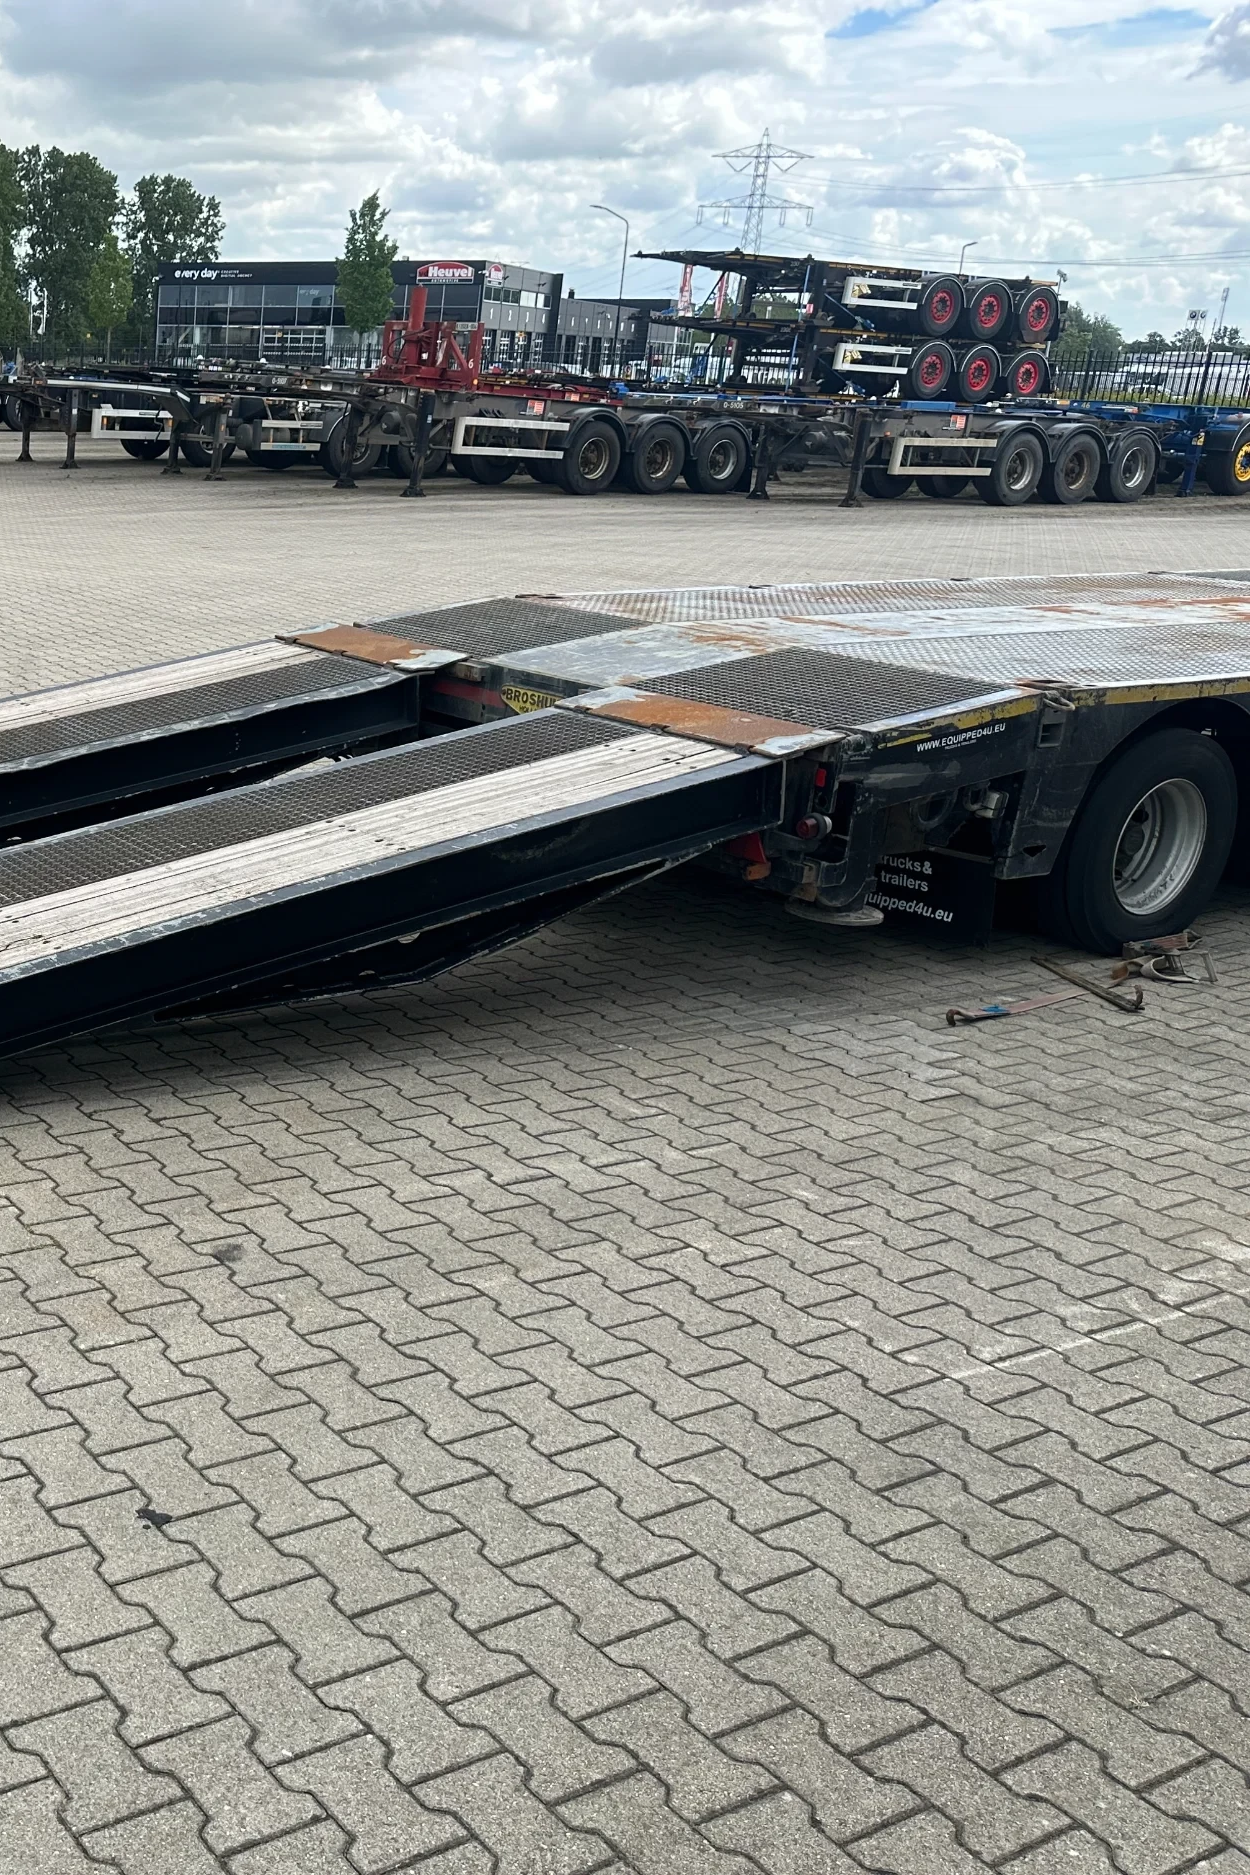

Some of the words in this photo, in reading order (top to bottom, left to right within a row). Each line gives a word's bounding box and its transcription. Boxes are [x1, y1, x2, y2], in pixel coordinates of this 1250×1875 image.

[175, 269, 200, 280] every
[201, 267, 218, 280] day
[428, 266, 472, 278] Heuvel
[469, 359, 474, 369] 6
[916, 722, 1006, 753] WWW.EQUIPPED4U.EU
[881, 870, 929, 892] trailers
